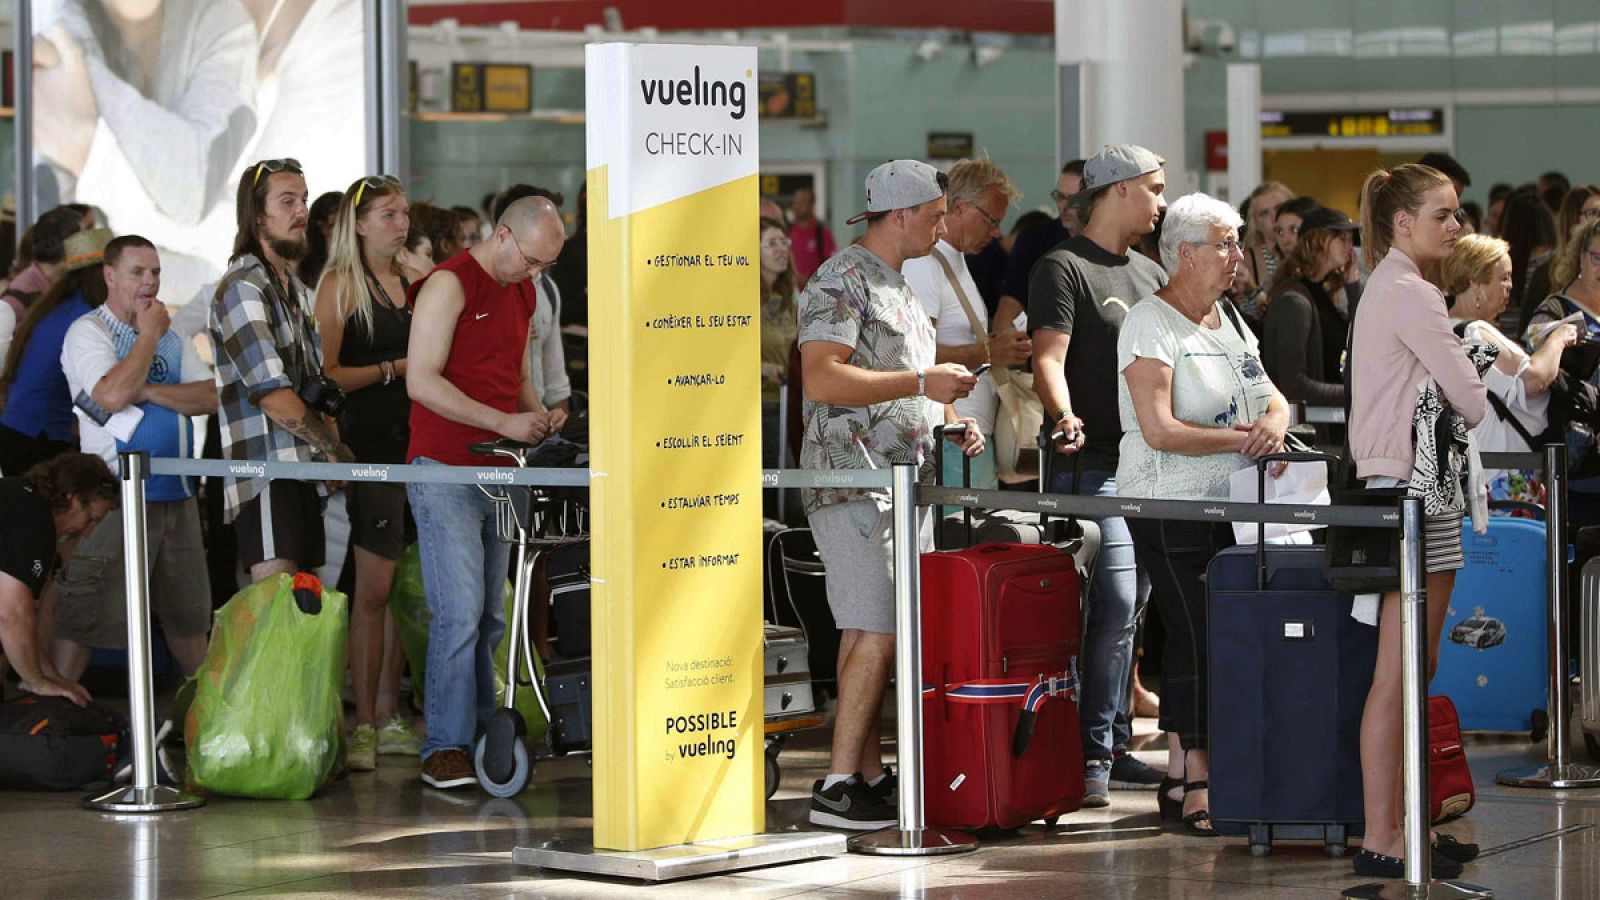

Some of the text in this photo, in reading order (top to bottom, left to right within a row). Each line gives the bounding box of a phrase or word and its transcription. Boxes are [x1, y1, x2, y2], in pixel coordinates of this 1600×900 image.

[641, 65, 746, 120] vueling
[645, 132, 742, 155] CHECK-IN
[704, 254, 714, 266] EL
[717, 254, 733, 266] TEU
[735, 255, 749, 266] VOL
[695, 315, 705, 328] EL
[709, 315, 724, 327] SEU
[727, 315, 752, 327] ESTAT
[674, 373, 725, 387] AVANÇAR-LO
[702, 435, 712, 447] EL
[229, 462, 265, 476] vueling
[351, 466, 388, 480] vueling
[477, 469, 515, 484] vueling
[713, 493, 739, 506] TEMPS
[669, 556, 696, 569] ESTAR
[666, 660, 688, 672] Nova
[666, 711, 737, 735] POSSIBLE
[679, 734, 736, 760] vueling
